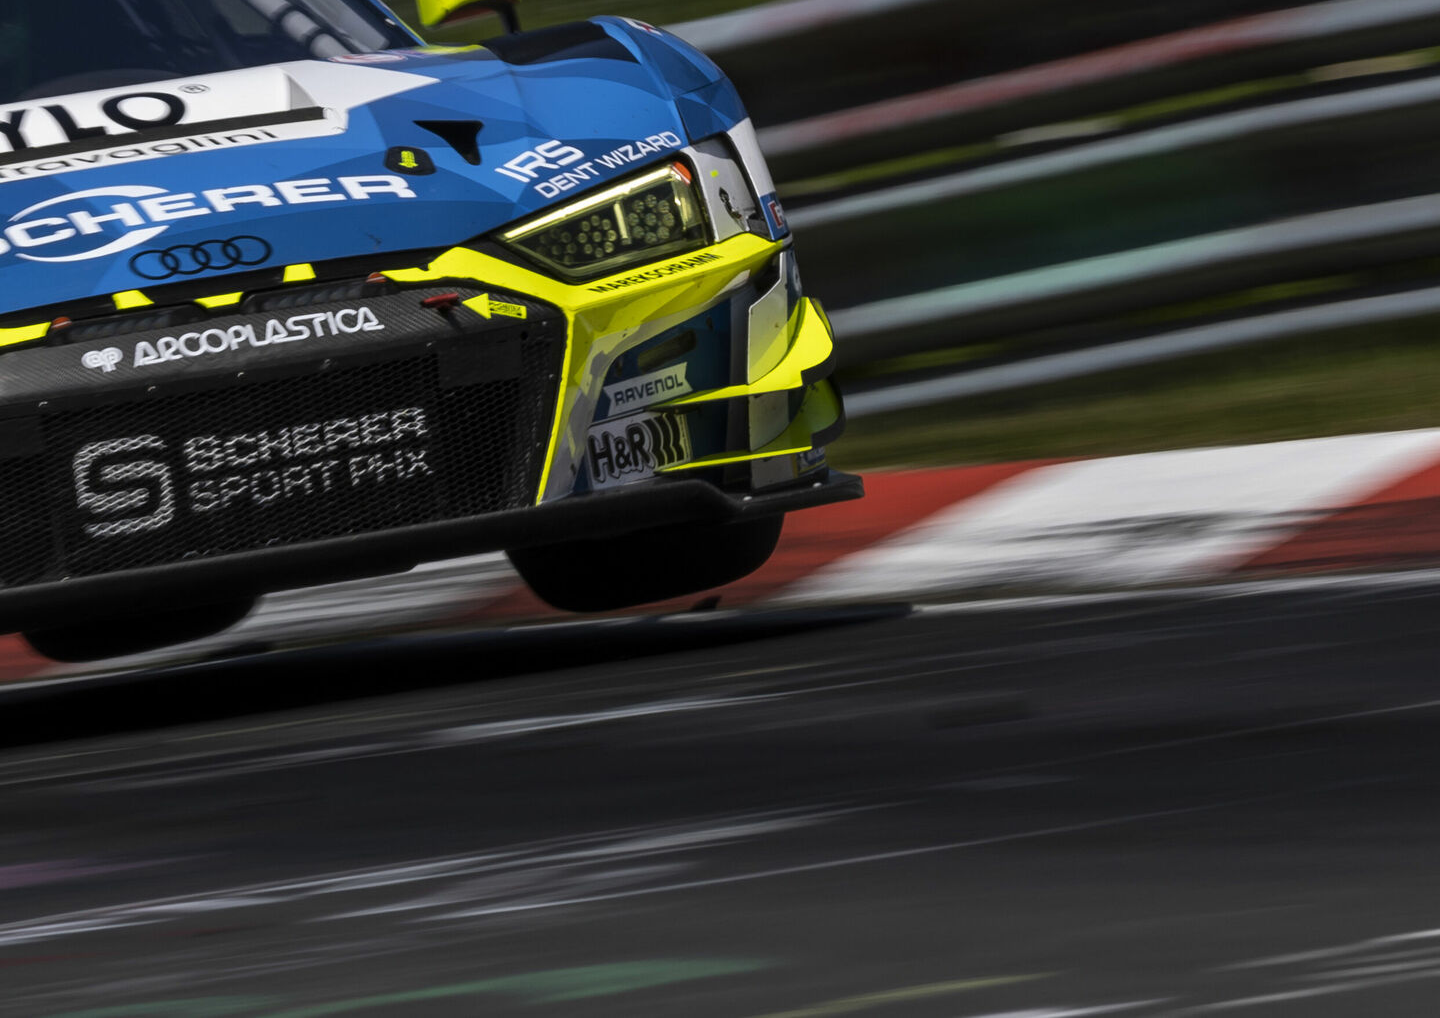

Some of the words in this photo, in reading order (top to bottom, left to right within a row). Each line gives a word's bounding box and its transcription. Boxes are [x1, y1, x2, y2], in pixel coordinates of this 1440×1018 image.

[494, 139, 585, 183] IRS
[533, 161, 601, 199] DENT
[594, 131, 682, 170] WIZARD
[133, 306, 386, 368] ARCOPLASTICA
[613, 373, 684, 406] RAVENOL
[184, 407, 428, 472] SCHERER
[189, 460, 340, 512] SPORT
[348, 449, 435, 486] PHX
